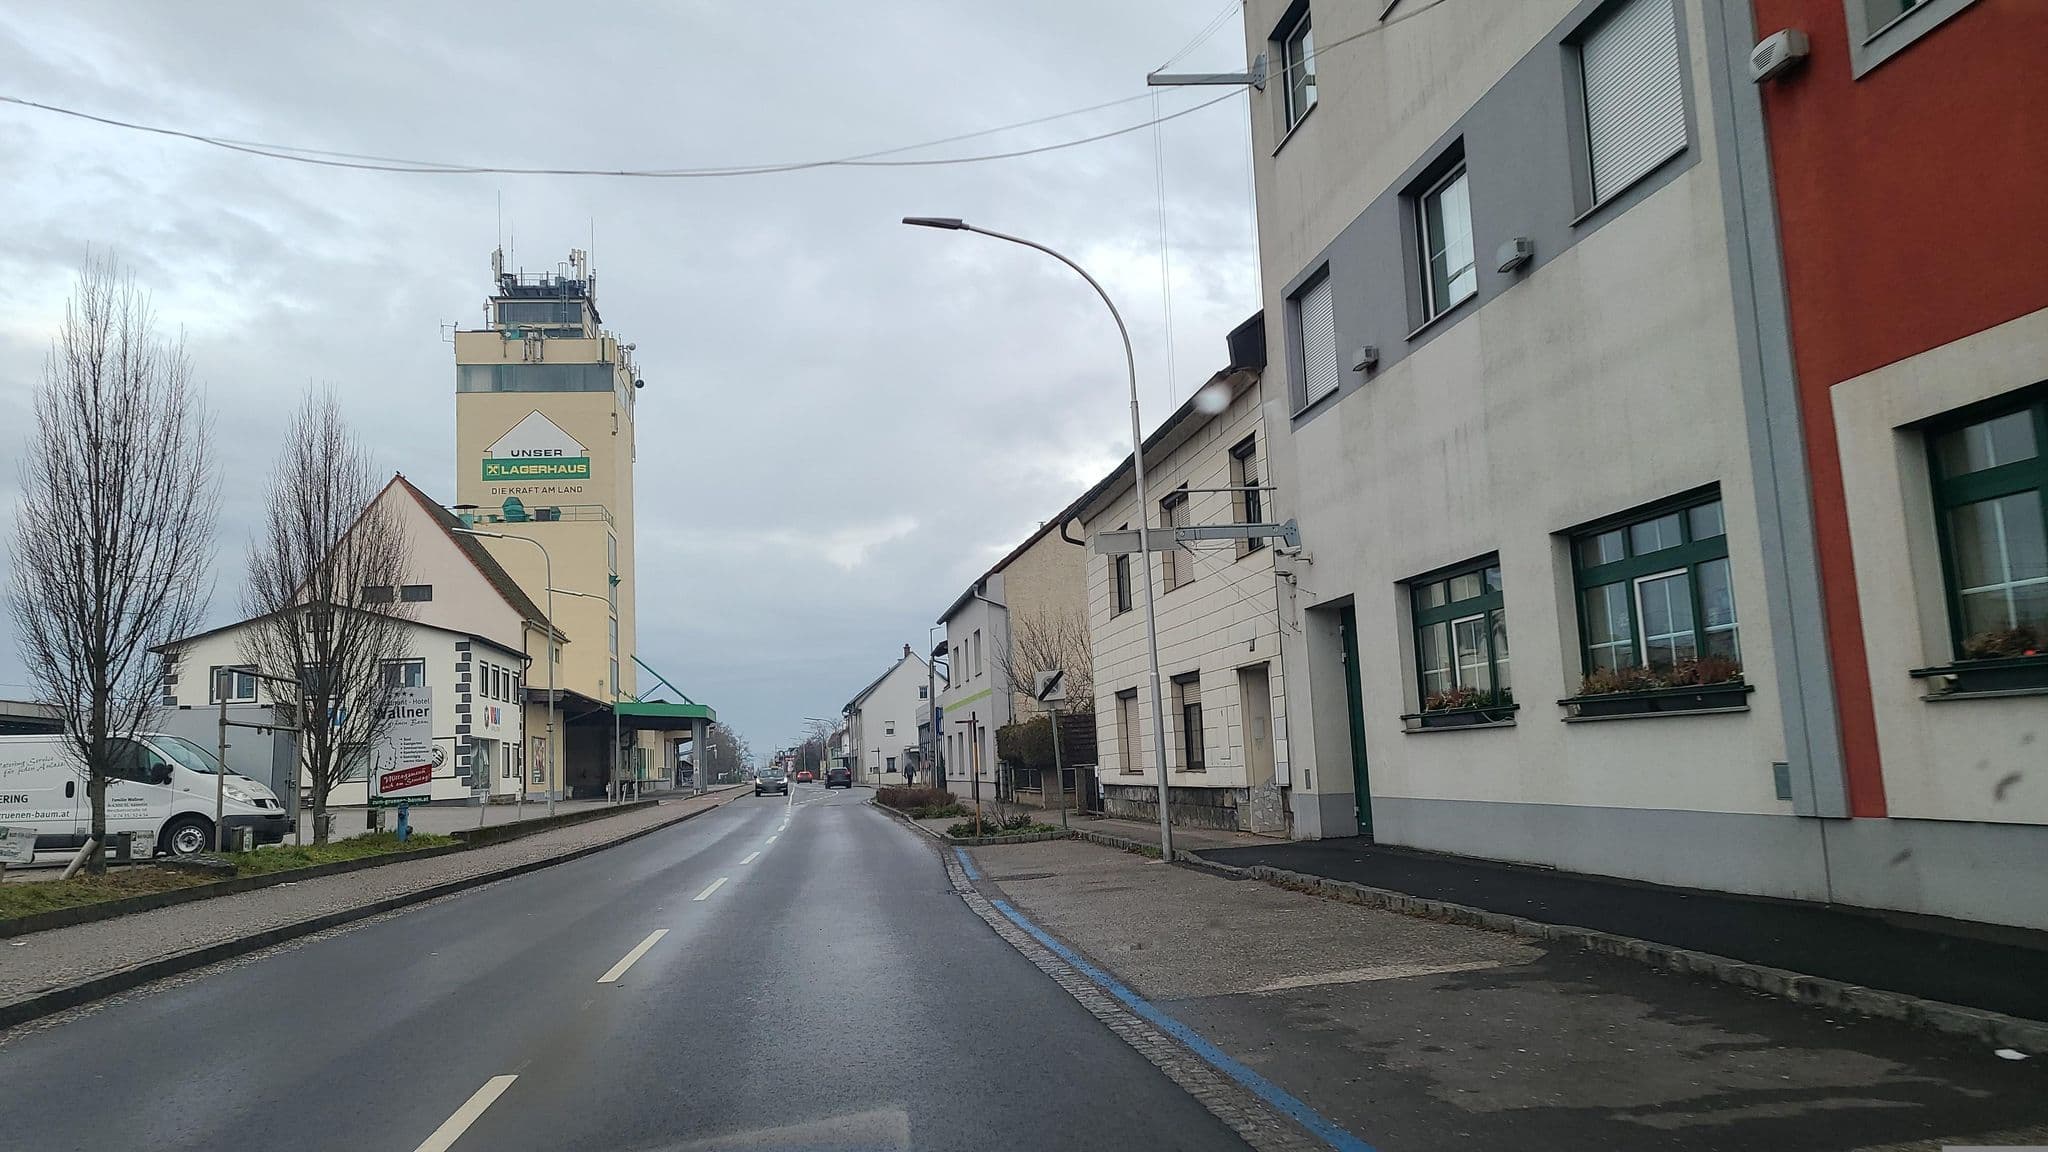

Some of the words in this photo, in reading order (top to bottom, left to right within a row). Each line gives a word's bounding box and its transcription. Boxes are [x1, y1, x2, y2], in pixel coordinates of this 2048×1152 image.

[511, 449, 563, 457] UNSER
[501, 464, 587, 475] LAGERHAUS
[491, 487, 507, 495] DIE
[508, 486, 539, 494] KRAFT
[541, 486, 556, 494] AM
[557, 485, 583, 493] LAND
[0, 810, 70, 819] ruenen-baum.at
